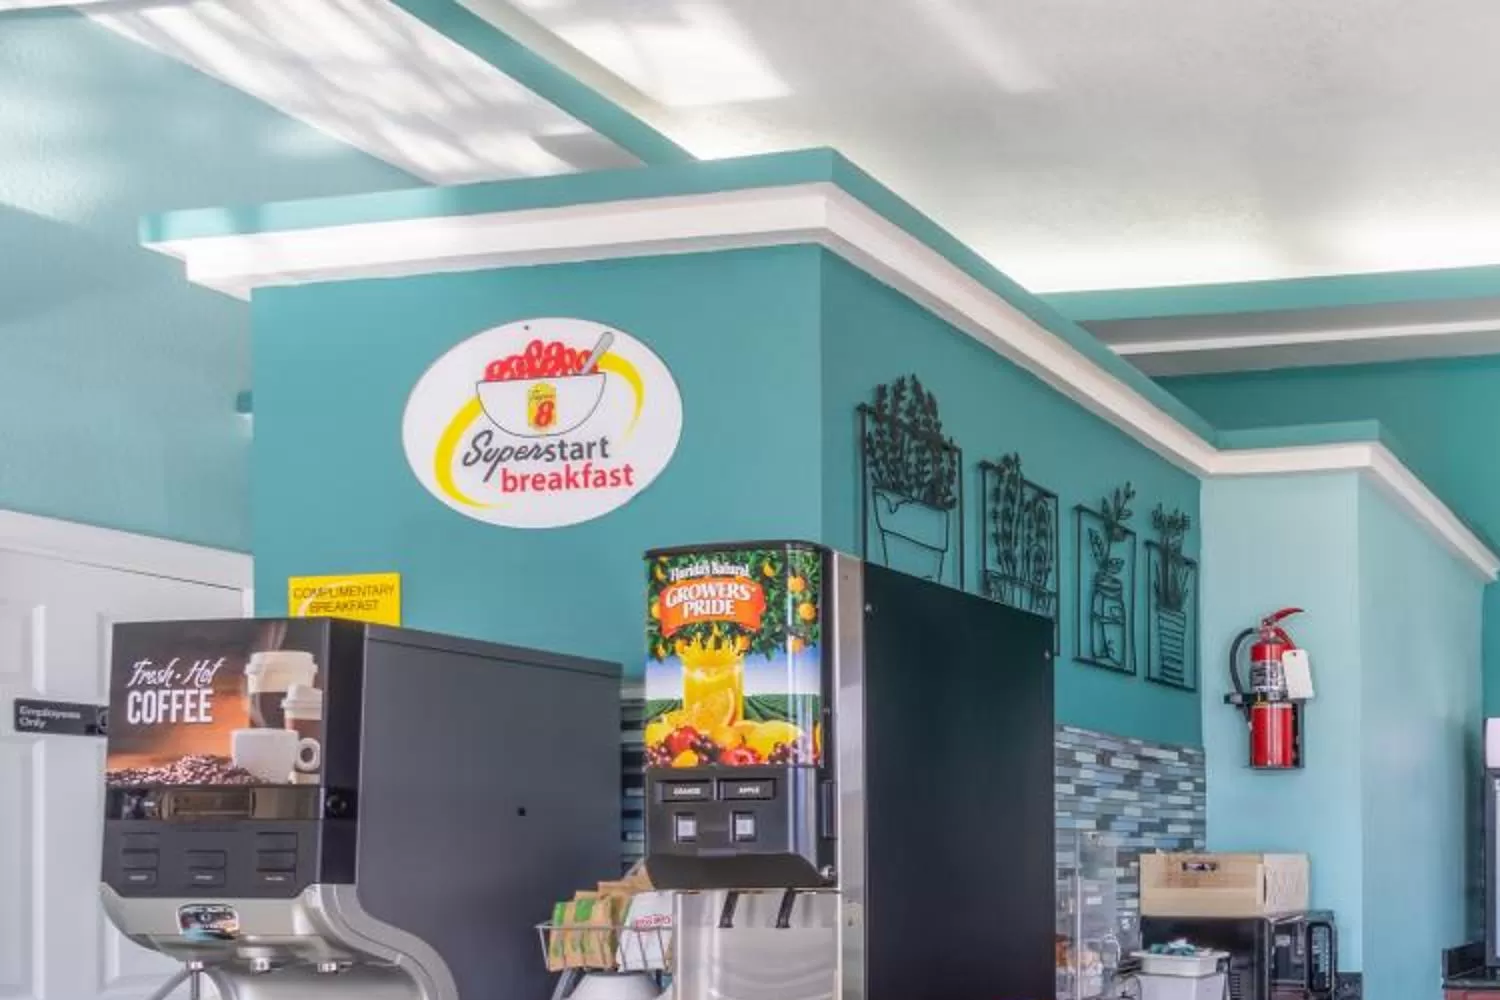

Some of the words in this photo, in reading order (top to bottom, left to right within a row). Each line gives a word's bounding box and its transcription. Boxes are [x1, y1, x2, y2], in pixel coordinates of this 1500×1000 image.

[534, 400, 555, 427] 8
[462, 430, 610, 483] Superstart
[501, 463, 635, 492] breakfast
[293, 584, 395, 599] COMPLIMENTARY
[309, 600, 380, 612] BREAKFAST
[683, 600, 736, 618] PRIDE
[126, 657, 180, 688] Fresh
[180, 657, 226, 688] Hot
[127, 688, 214, 724] COFFEE
